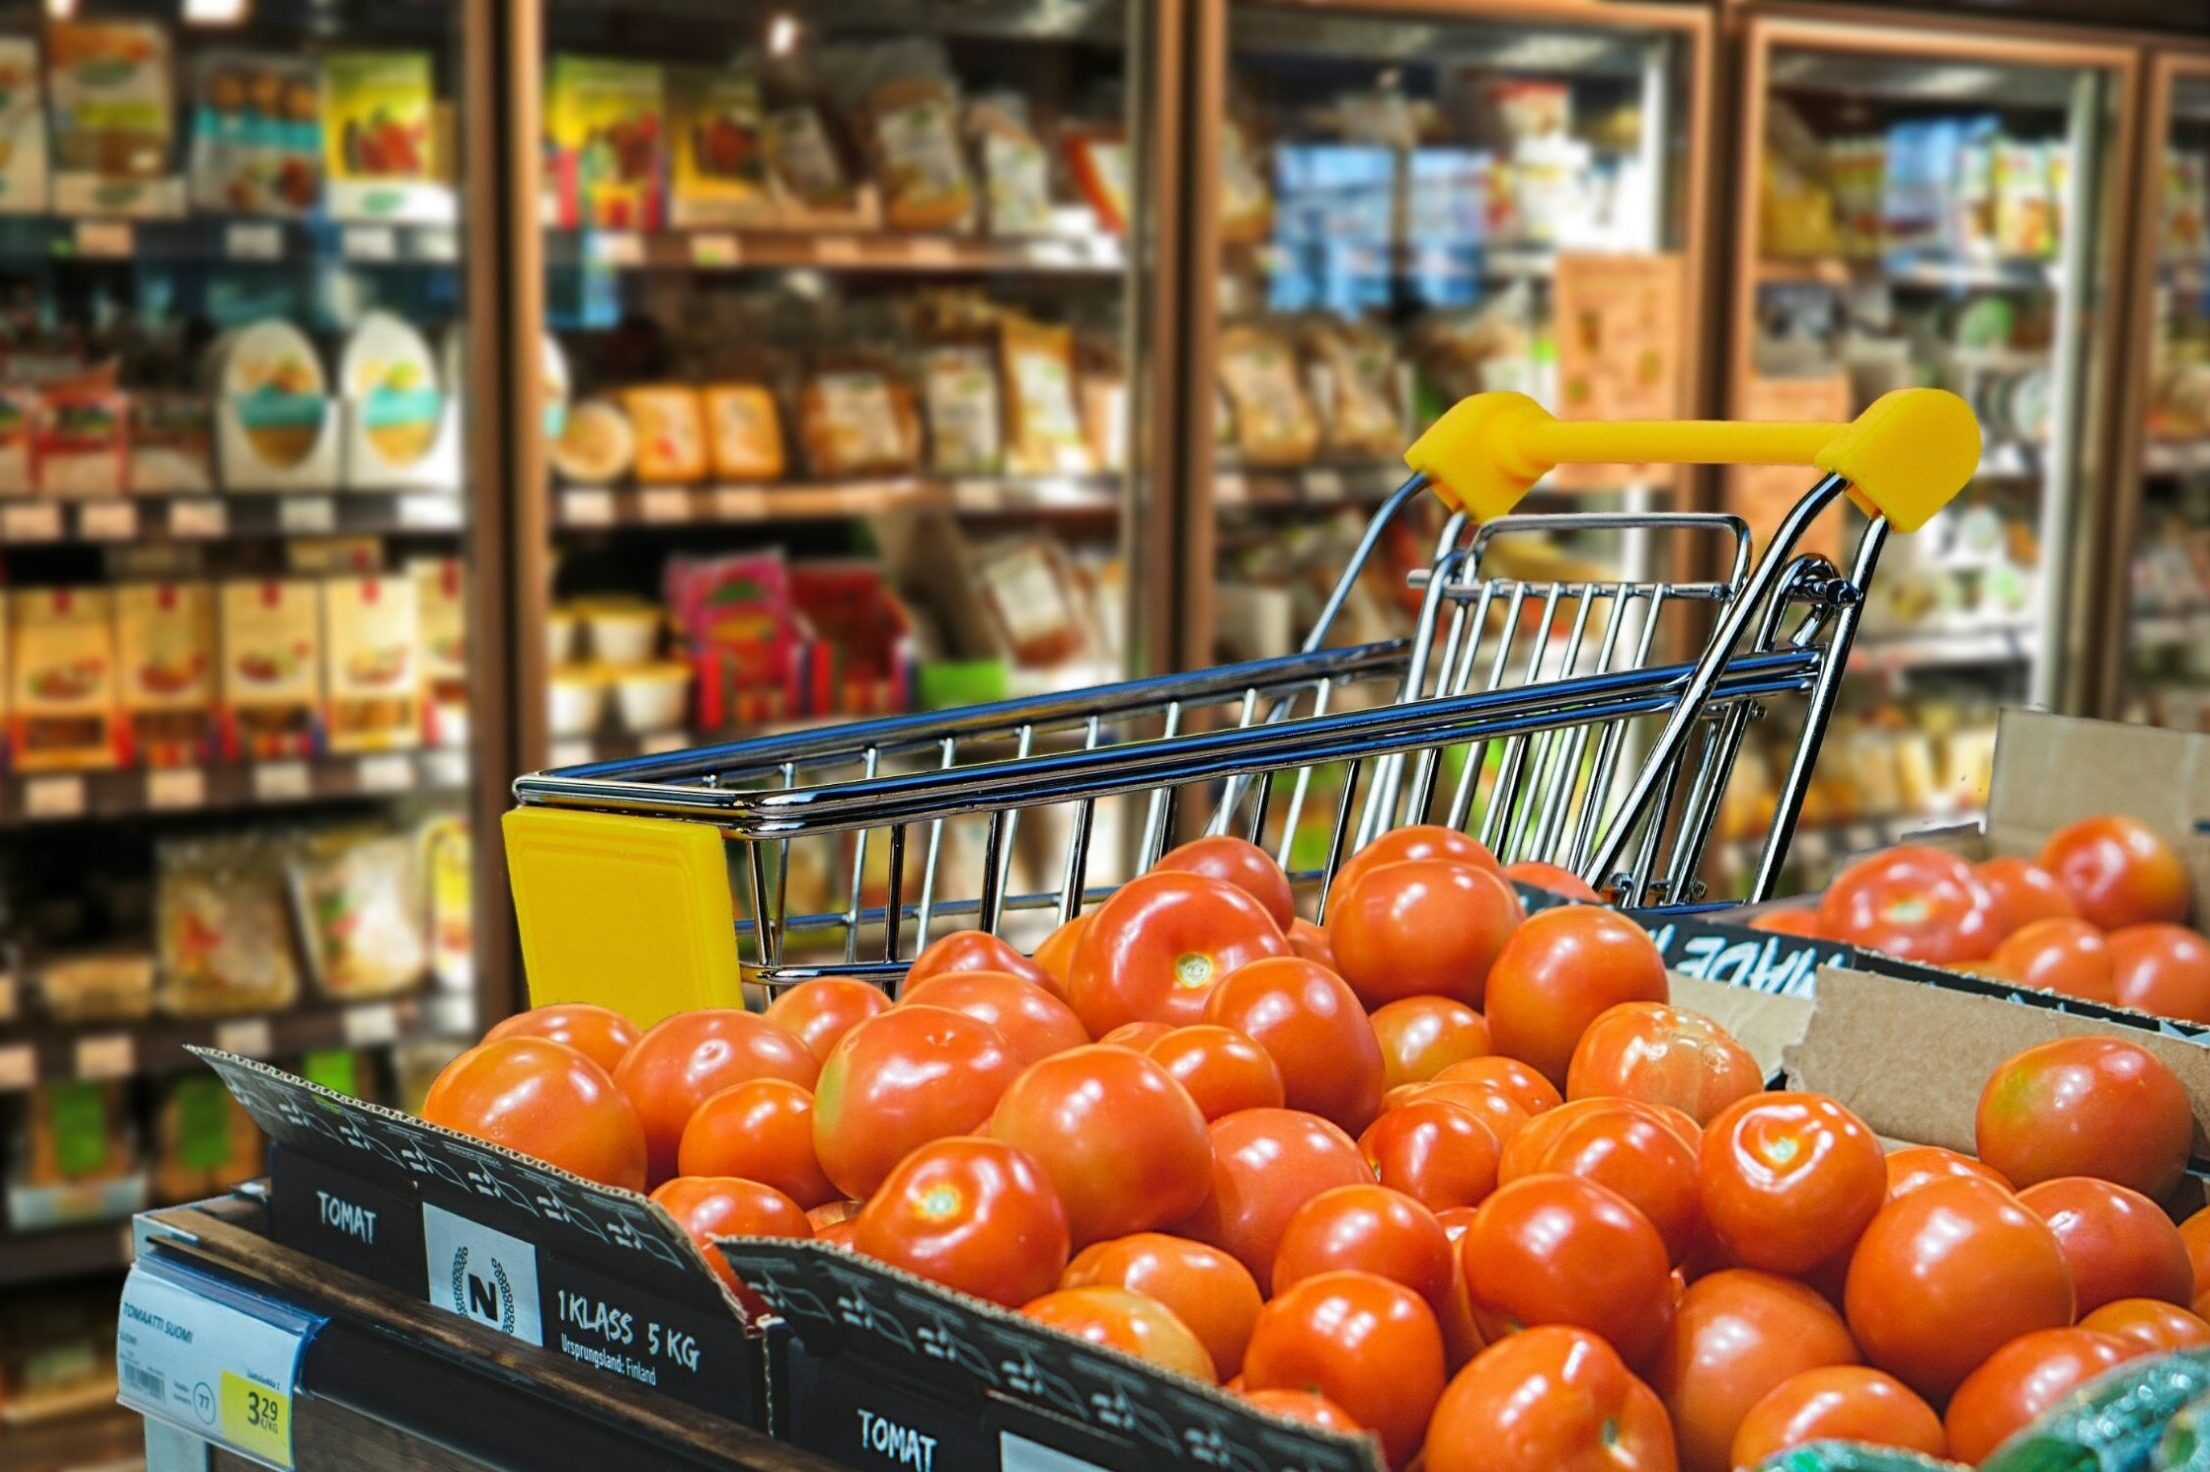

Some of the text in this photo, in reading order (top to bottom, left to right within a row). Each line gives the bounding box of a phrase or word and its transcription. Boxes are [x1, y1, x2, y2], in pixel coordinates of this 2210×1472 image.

[316, 1190, 378, 1245] TOMAT
[123, 1302, 193, 1344] TOMAATTI SUOMI
[468, 1273, 498, 1321] N
[568, 1290, 634, 1344] KLASS
[647, 1323, 660, 1356] 5
[666, 1328, 701, 1373] KG
[561, 1333, 657, 1386] Ursprungsland: Finland
[198, 1393, 210, 1411] 77
[857, 1408, 938, 1472] TOMAT
